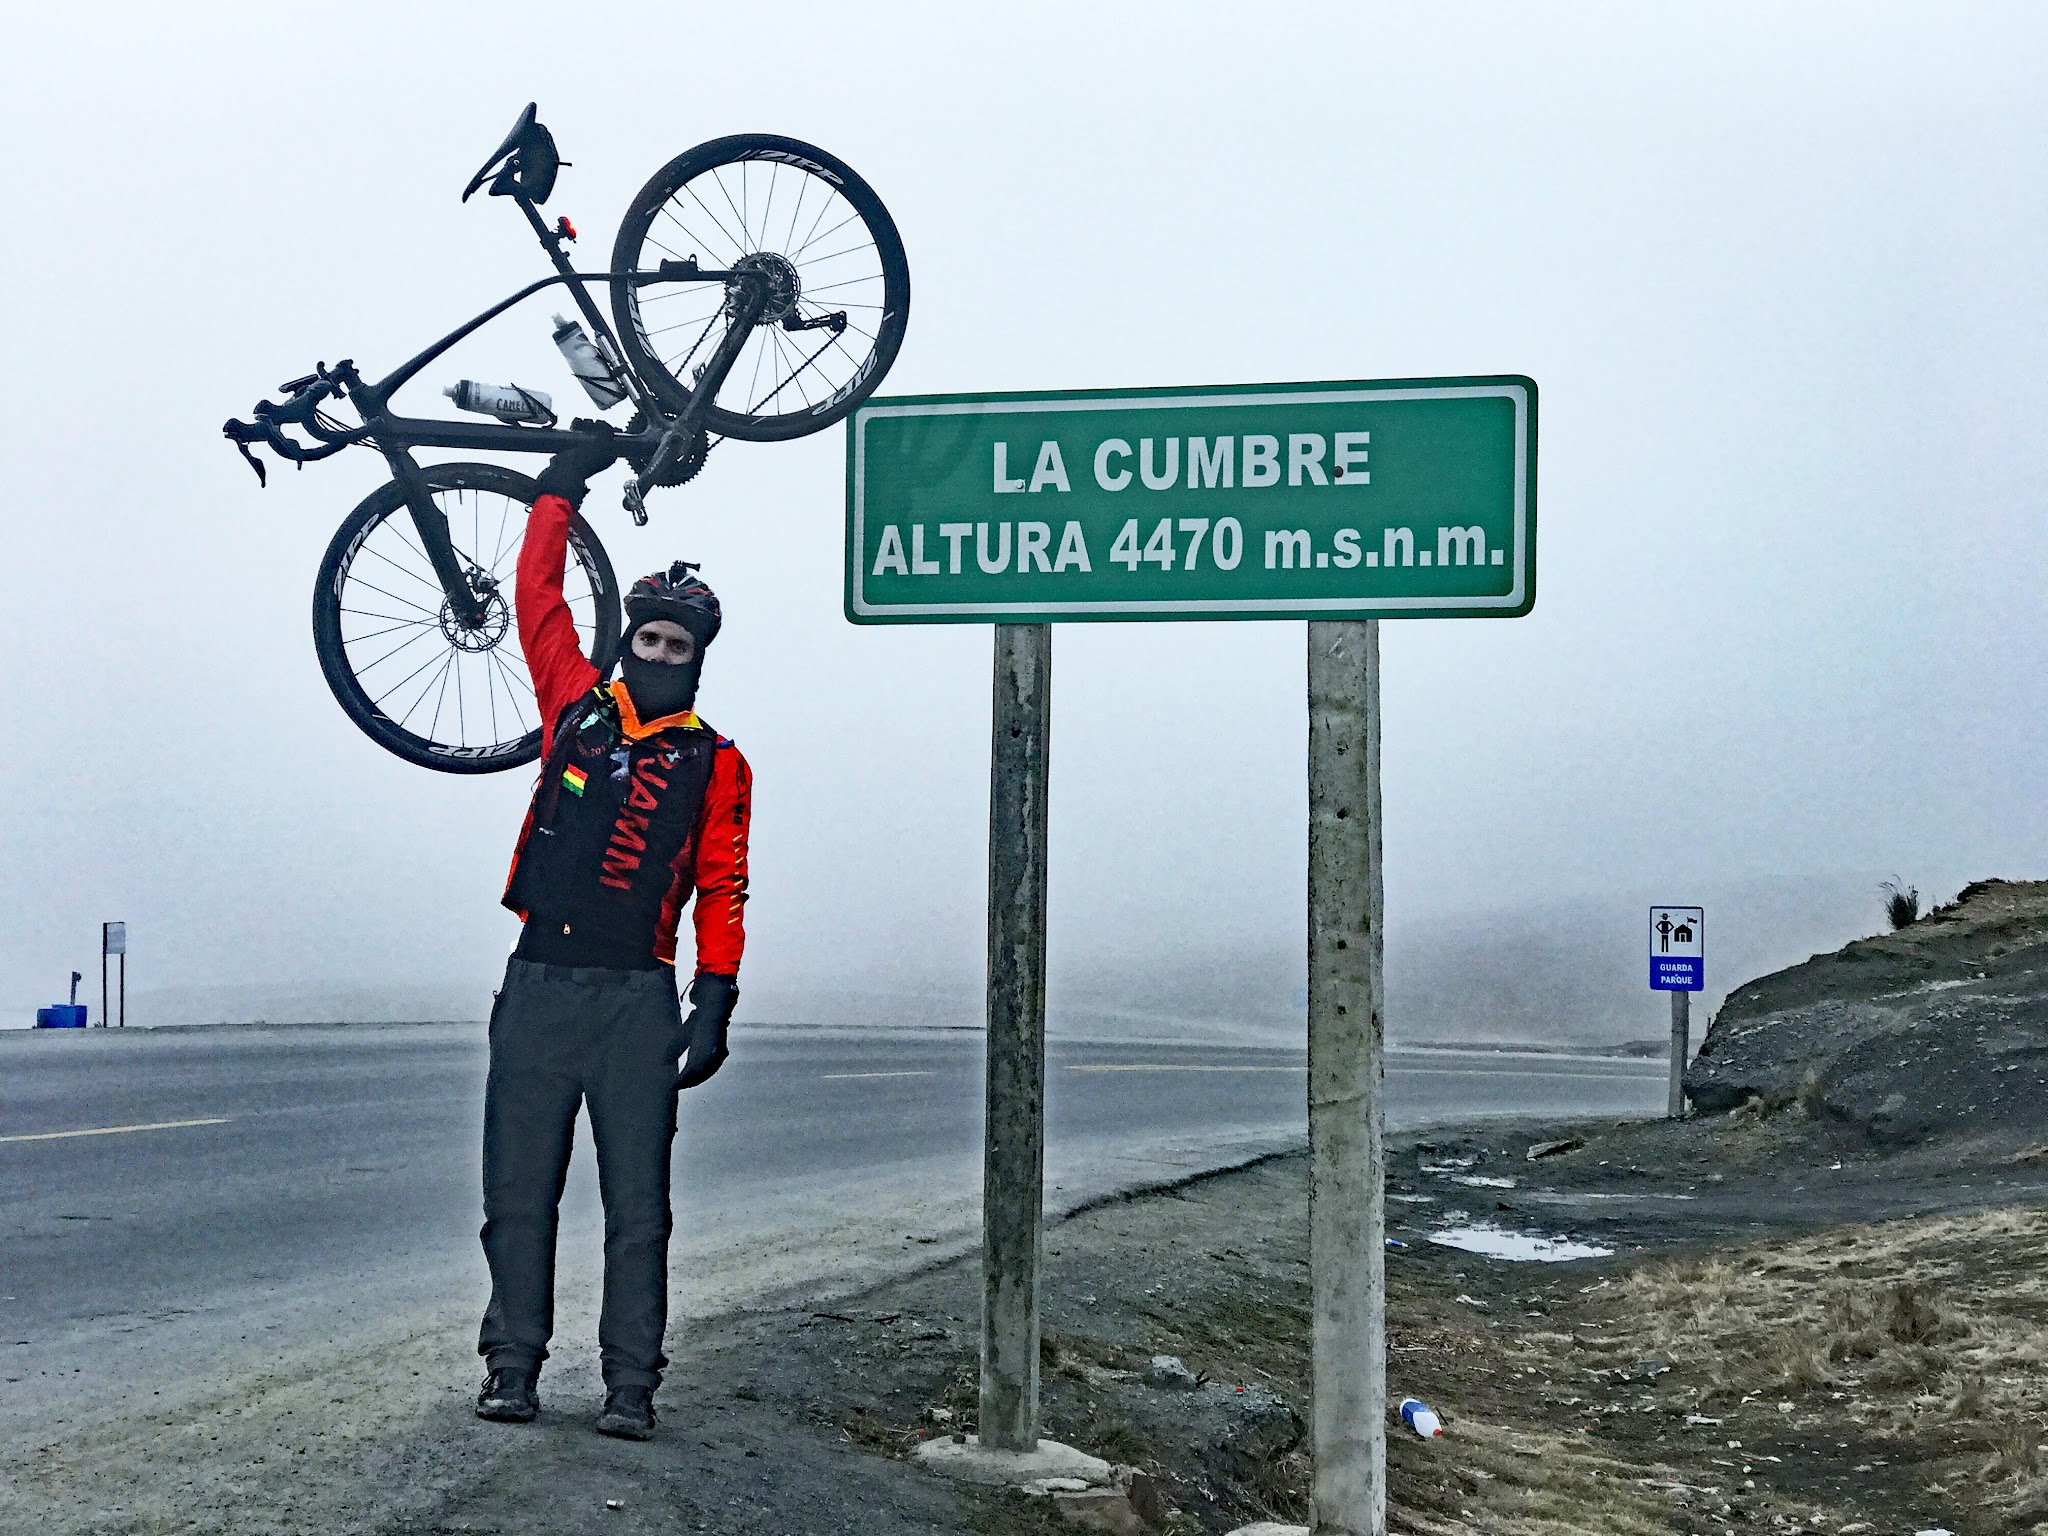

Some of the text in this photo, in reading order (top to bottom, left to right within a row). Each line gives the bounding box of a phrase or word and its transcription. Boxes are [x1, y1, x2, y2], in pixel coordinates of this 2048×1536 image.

[994, 432, 1370, 493] LA CUMBRE
[873, 517, 1504, 575] ALTURA 4470 m.s.n.m.
[1659, 963, 1694, 972] GUARDA
[1660, 976, 1693, 985] PARQUE
